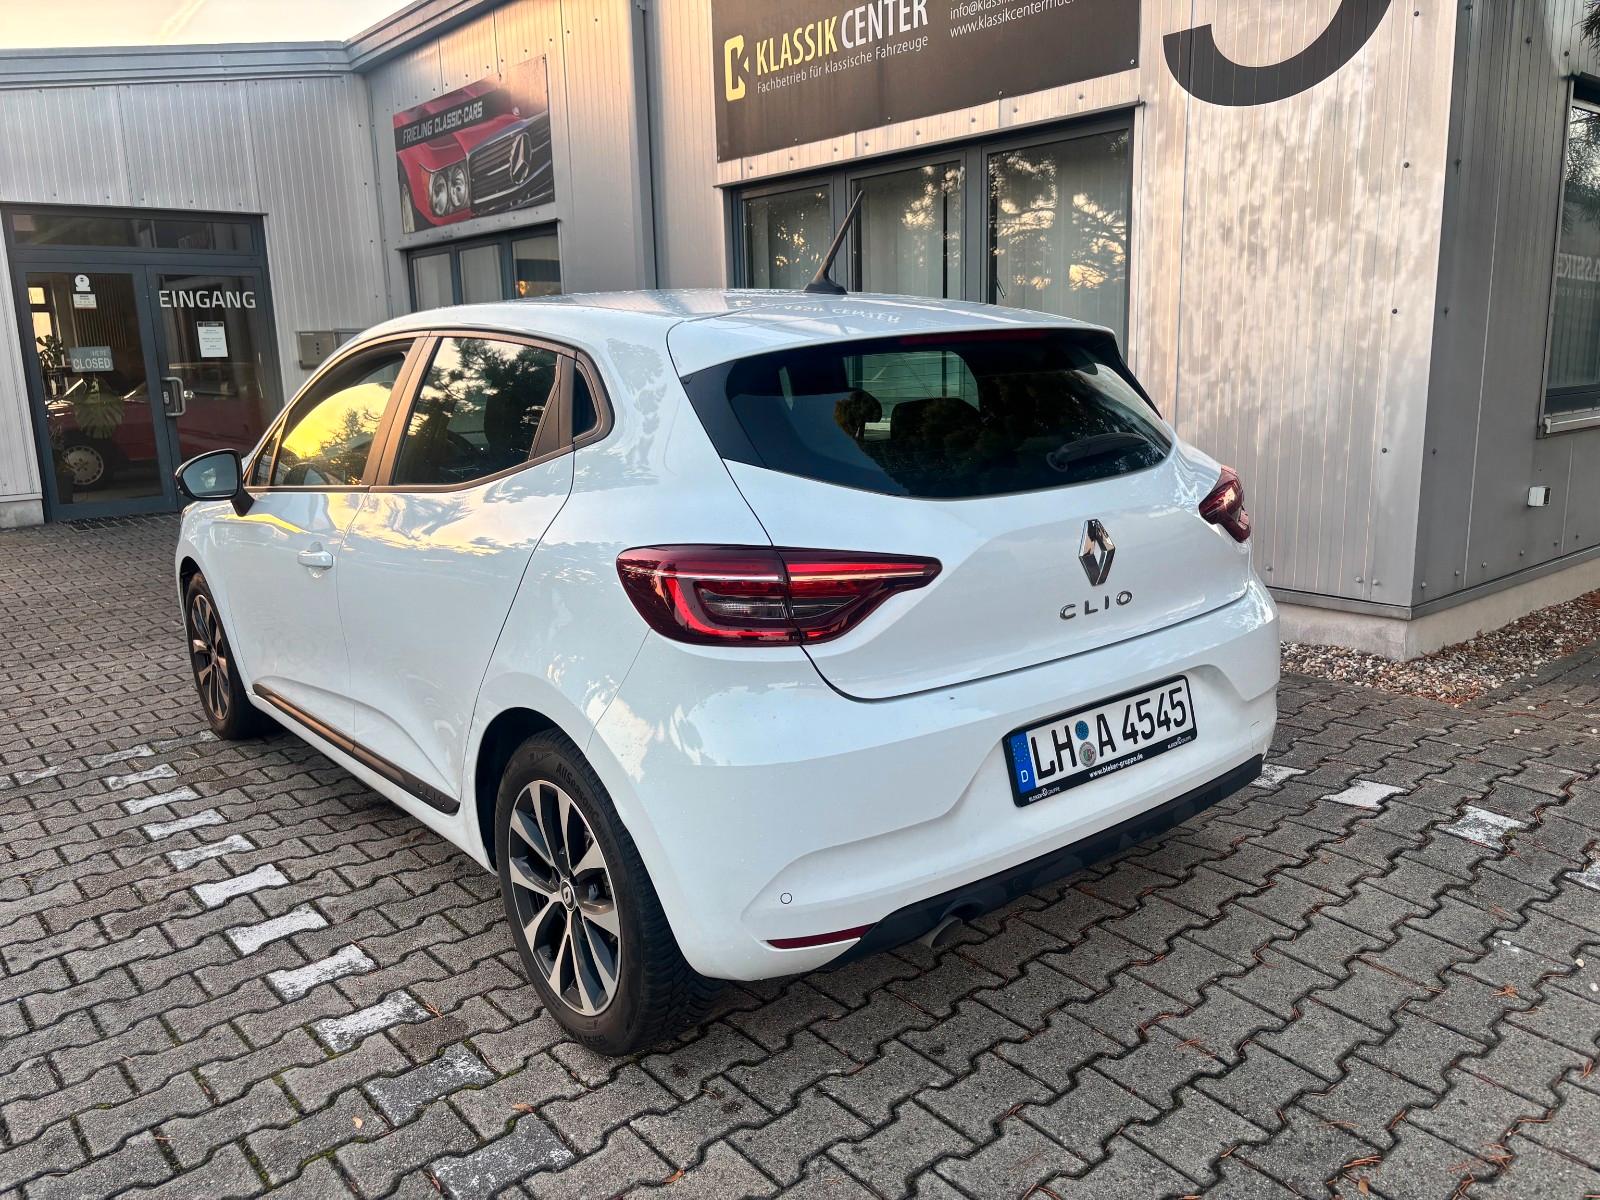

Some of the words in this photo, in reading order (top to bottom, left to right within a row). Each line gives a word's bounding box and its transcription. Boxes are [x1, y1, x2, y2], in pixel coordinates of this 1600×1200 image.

[756, 16, 838, 76] KLASSIK
[841, 0, 929, 49] CENTER
[757, 71, 807, 94] Fachbetrieb
[809, 65, 823, 78] für
[825, 51, 873, 73] klassische
[875, 35, 929, 60] Fahrzeuge
[403, 119, 433, 144] FRIELING
[158, 290, 256, 309] EINGANG
[73, 357, 110, 370] CLOSED
[1060, 591, 1132, 620] CLIO
[1031, 725, 1077, 780] LH
[1096, 713, 1117, 757] A
[1122, 687, 1187, 744] 4545
[1020, 769, 1029, 784] D
